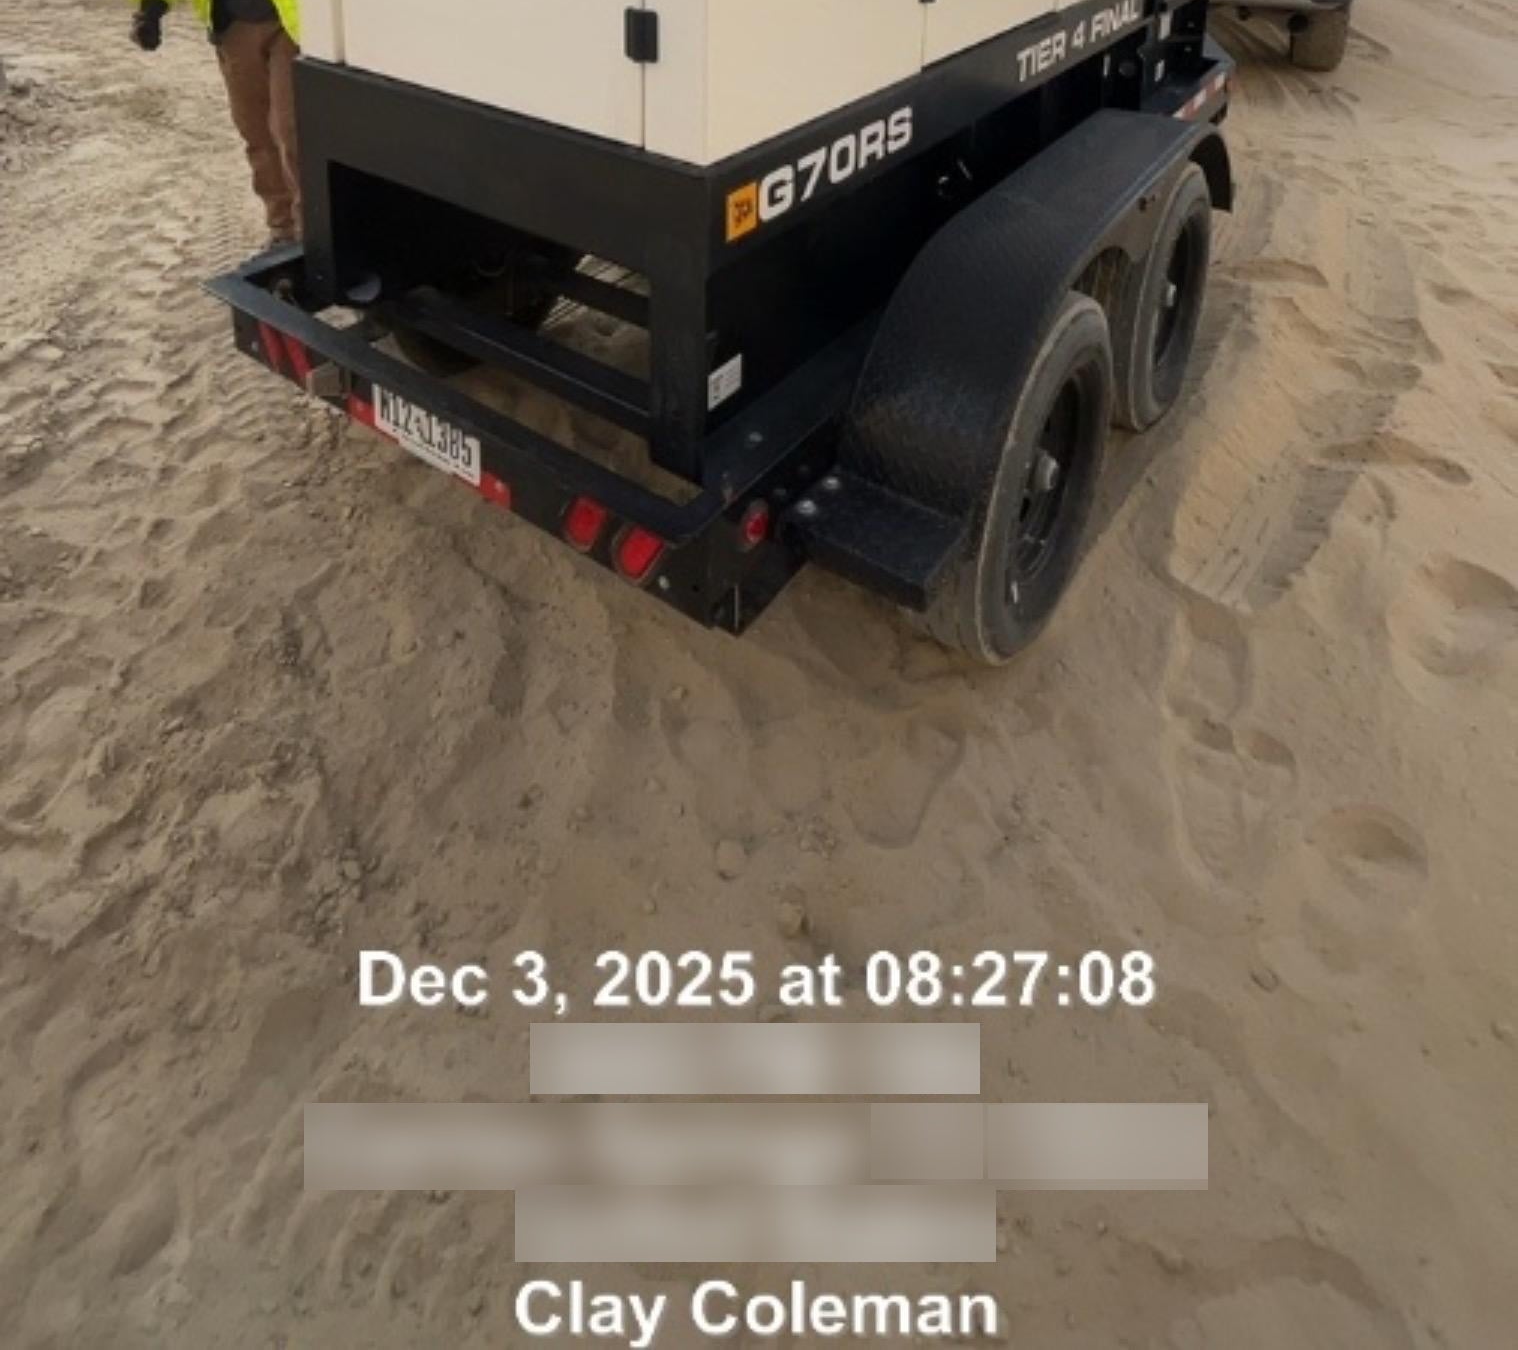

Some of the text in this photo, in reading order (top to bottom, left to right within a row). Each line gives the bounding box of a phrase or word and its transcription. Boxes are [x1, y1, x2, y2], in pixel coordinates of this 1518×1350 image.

[1016, 29, 1066, 83] TIER
[1072, 19, 1087, 49] 4
[758, 106, 912, 222] G70RS
